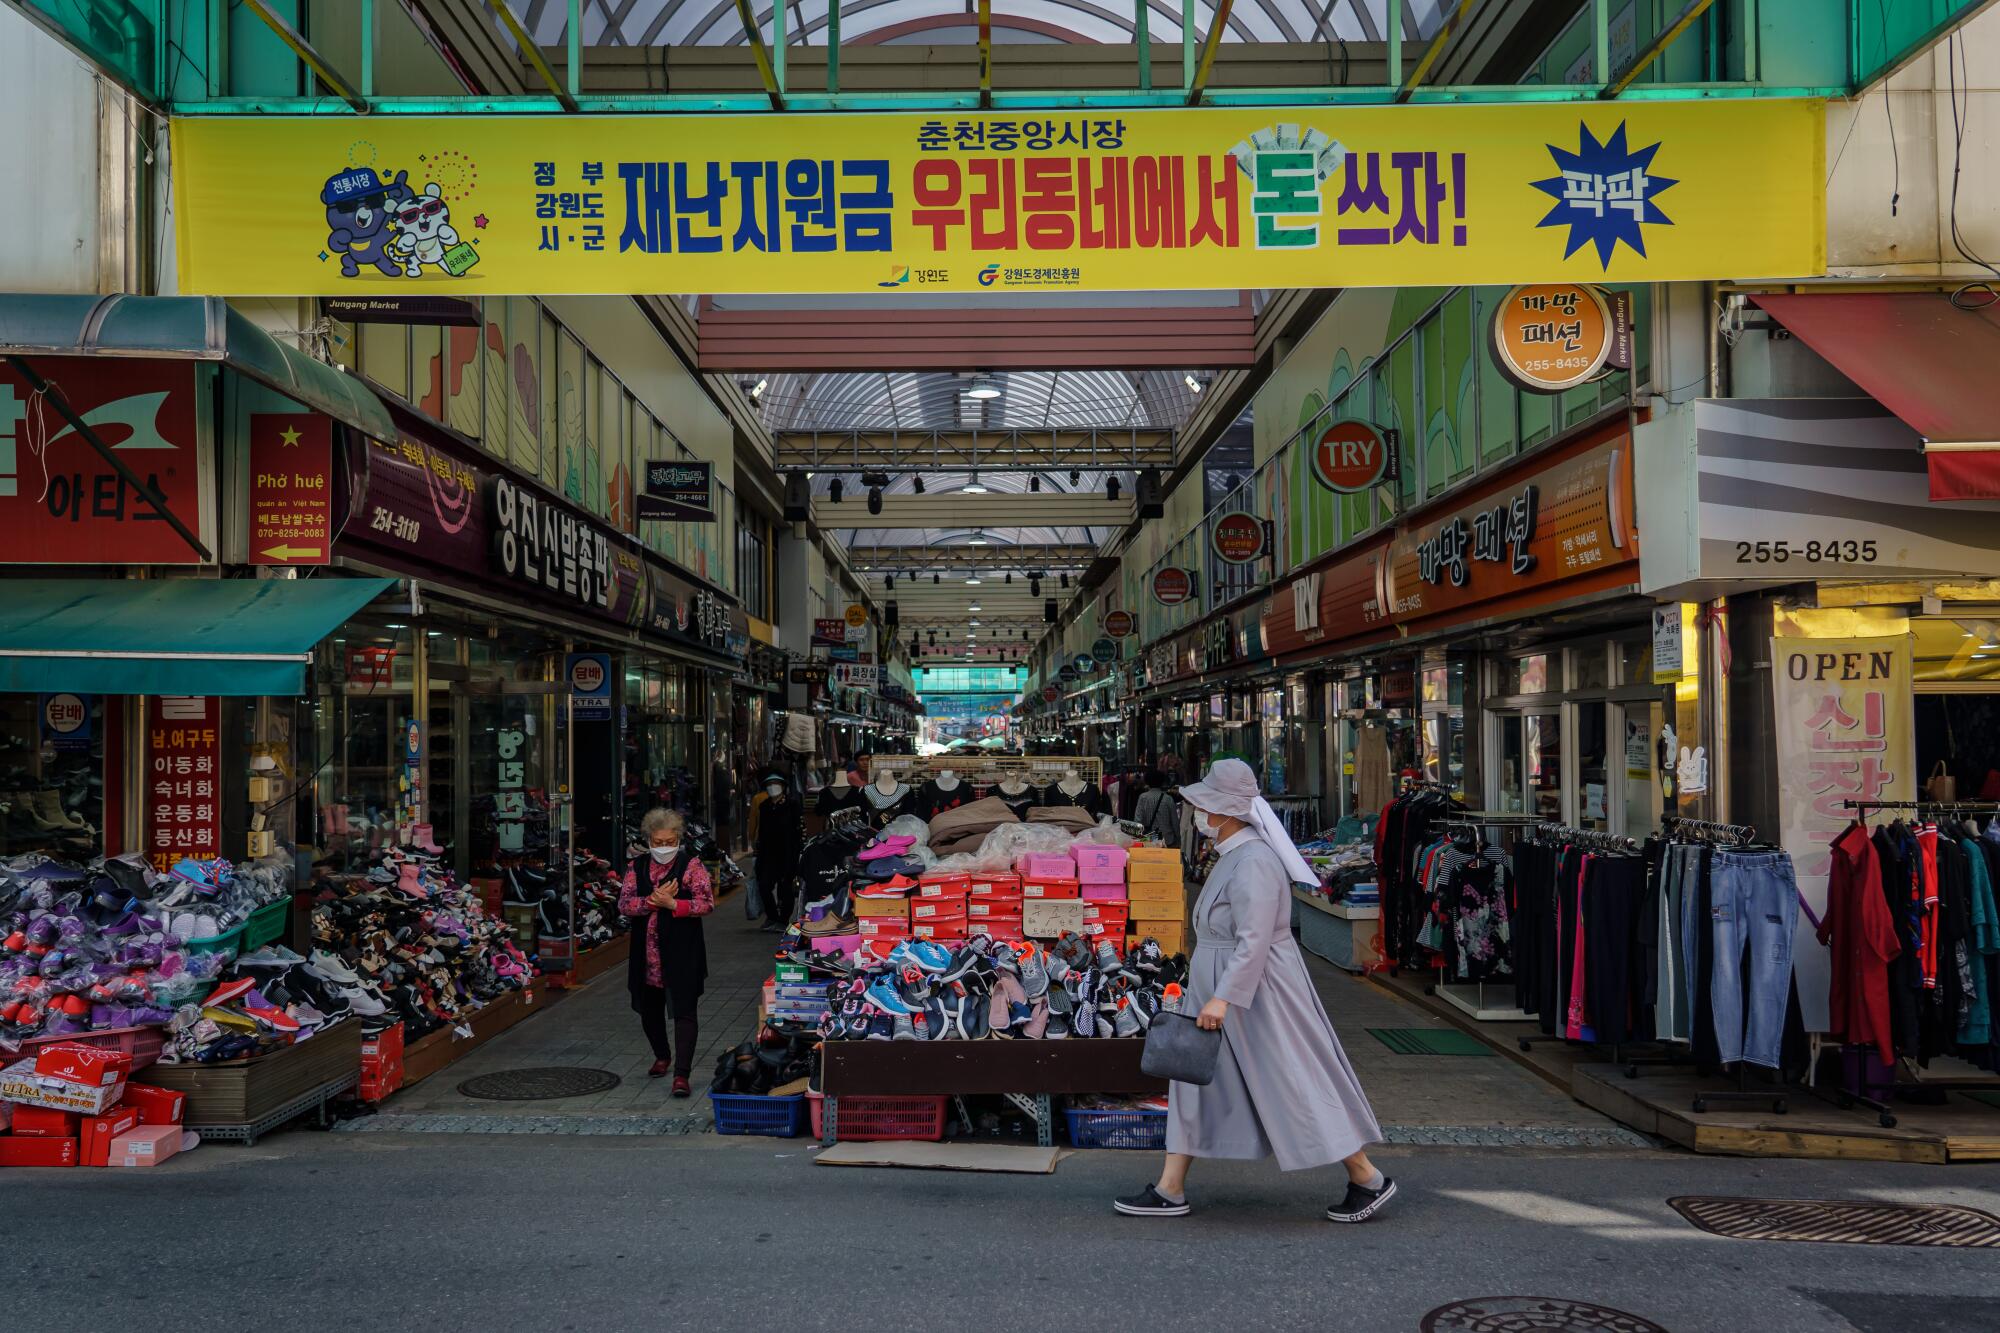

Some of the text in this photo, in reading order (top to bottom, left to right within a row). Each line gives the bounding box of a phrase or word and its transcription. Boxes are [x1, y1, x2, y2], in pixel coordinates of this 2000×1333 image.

[916, 119, 1127, 151] 춘천중앙시장
[332, 173, 371, 195] 전통시장
[617, 149, 1467, 254] 재난지원금 우리동네에서 돈 쓰자!
[1562, 166, 1649, 222] 팍팍
[535, 192, 605, 219] 강원도
[449, 250, 473, 269] 우리동네
[914, 269, 949, 283] 강원도
[1003, 267, 1080, 280] 강원도경제진흥원
[330, 300, 400, 310] Jungang Market
[1519, 292, 1582, 316] 까망
[1519, 320, 1584, 353] 패션
[1616, 297, 1628, 364] Jungang Market
[1525, 356, 1589, 371] 255-8435
[1323, 440, 1376, 468] TRY
[295, 473, 324, 490] huệ
[258, 513, 326, 526] 베트남쌀국수
[371, 505, 421, 543] 254-3118
[257, 529, 325, 538] 070-8258-0083
[1736, 540, 1878, 563] 255-8435
[1291, 573, 1320, 632] TRY
[575, 667, 601, 680] 담배
[852, 667, 877, 678] 화장실
[1788, 651, 1894, 681] OPEN
[50, 704, 82, 721] 담배
[155, 755, 214, 774] 아동화
[155, 780, 214, 799] 숙녀화
[155, 804, 214, 822] 운동화
[155, 828, 214, 847] 등산화
[3, 1083, 40, 1097] ULTRA
